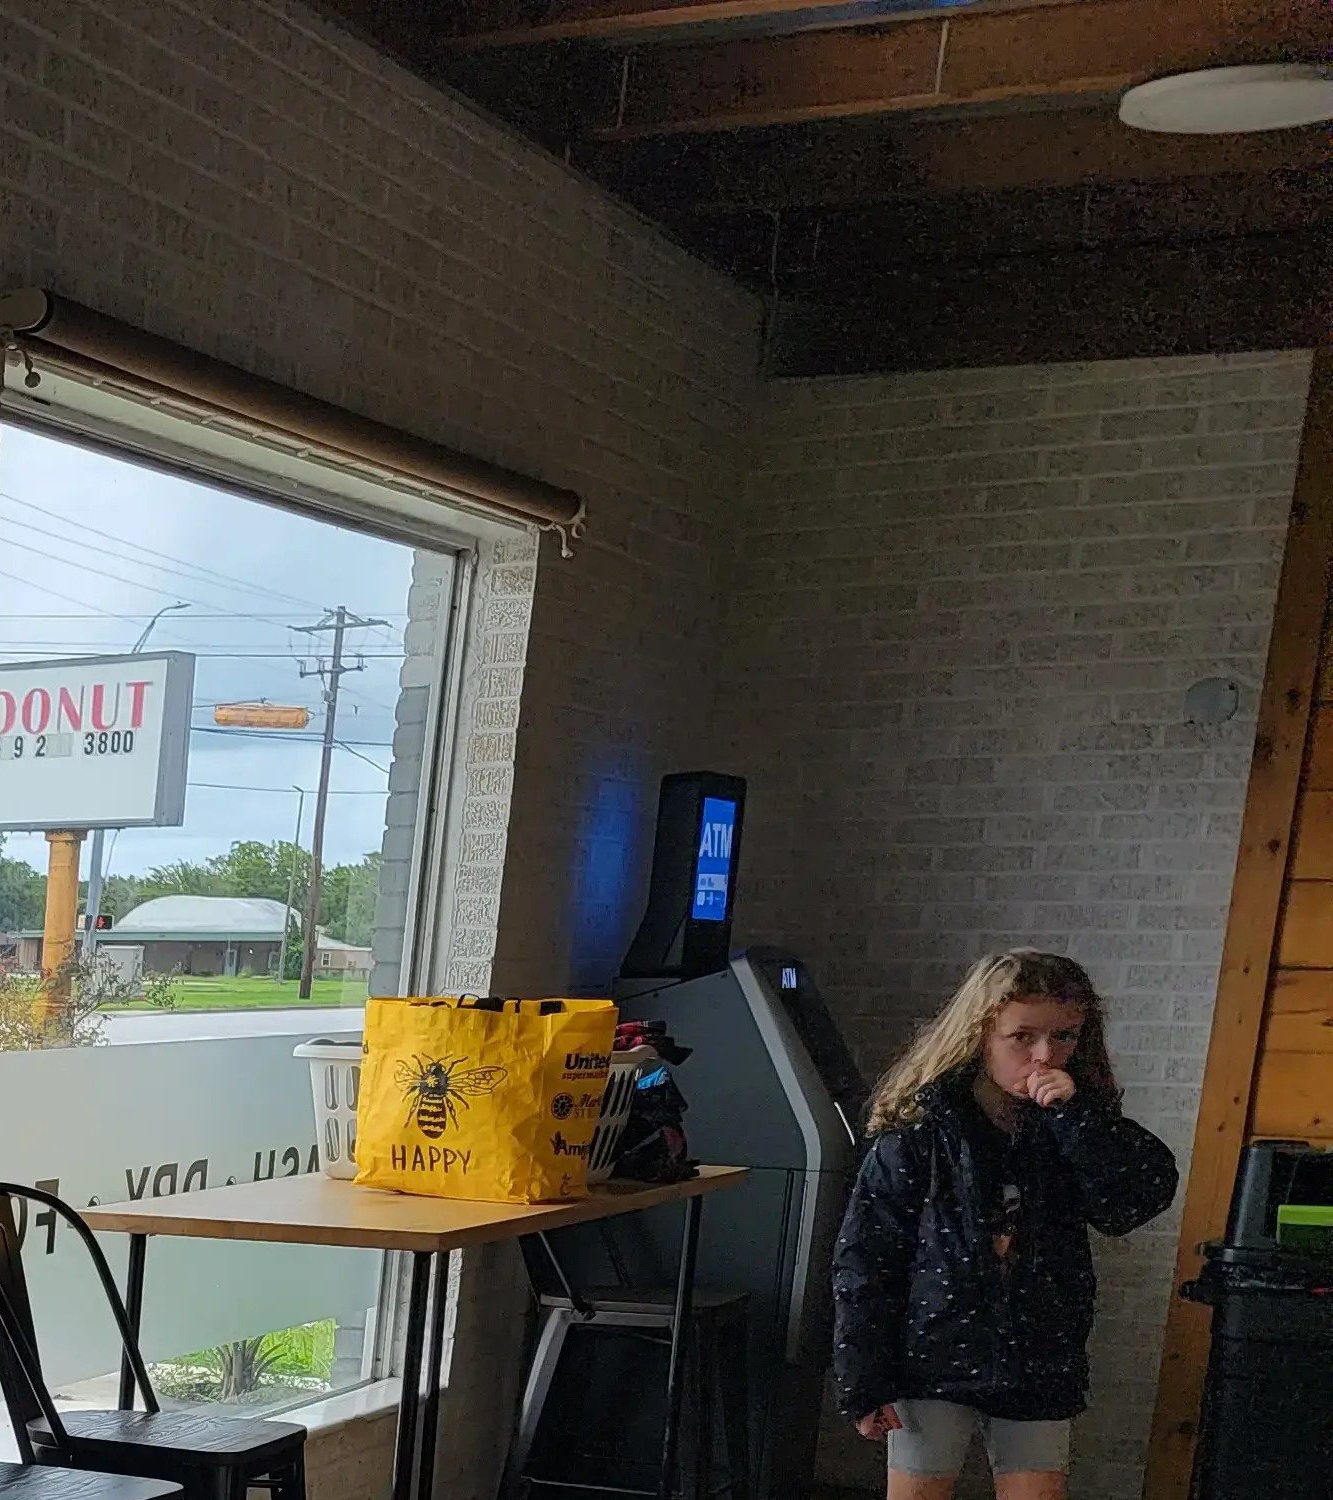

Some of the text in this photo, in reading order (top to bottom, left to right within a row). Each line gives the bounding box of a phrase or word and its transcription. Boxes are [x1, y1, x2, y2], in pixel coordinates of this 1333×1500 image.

[83, 730, 134, 754] 3800
[698, 822, 733, 859] ATM
[781, 967, 797, 989] ATM
[391, 1143, 473, 1176] HAPPY
